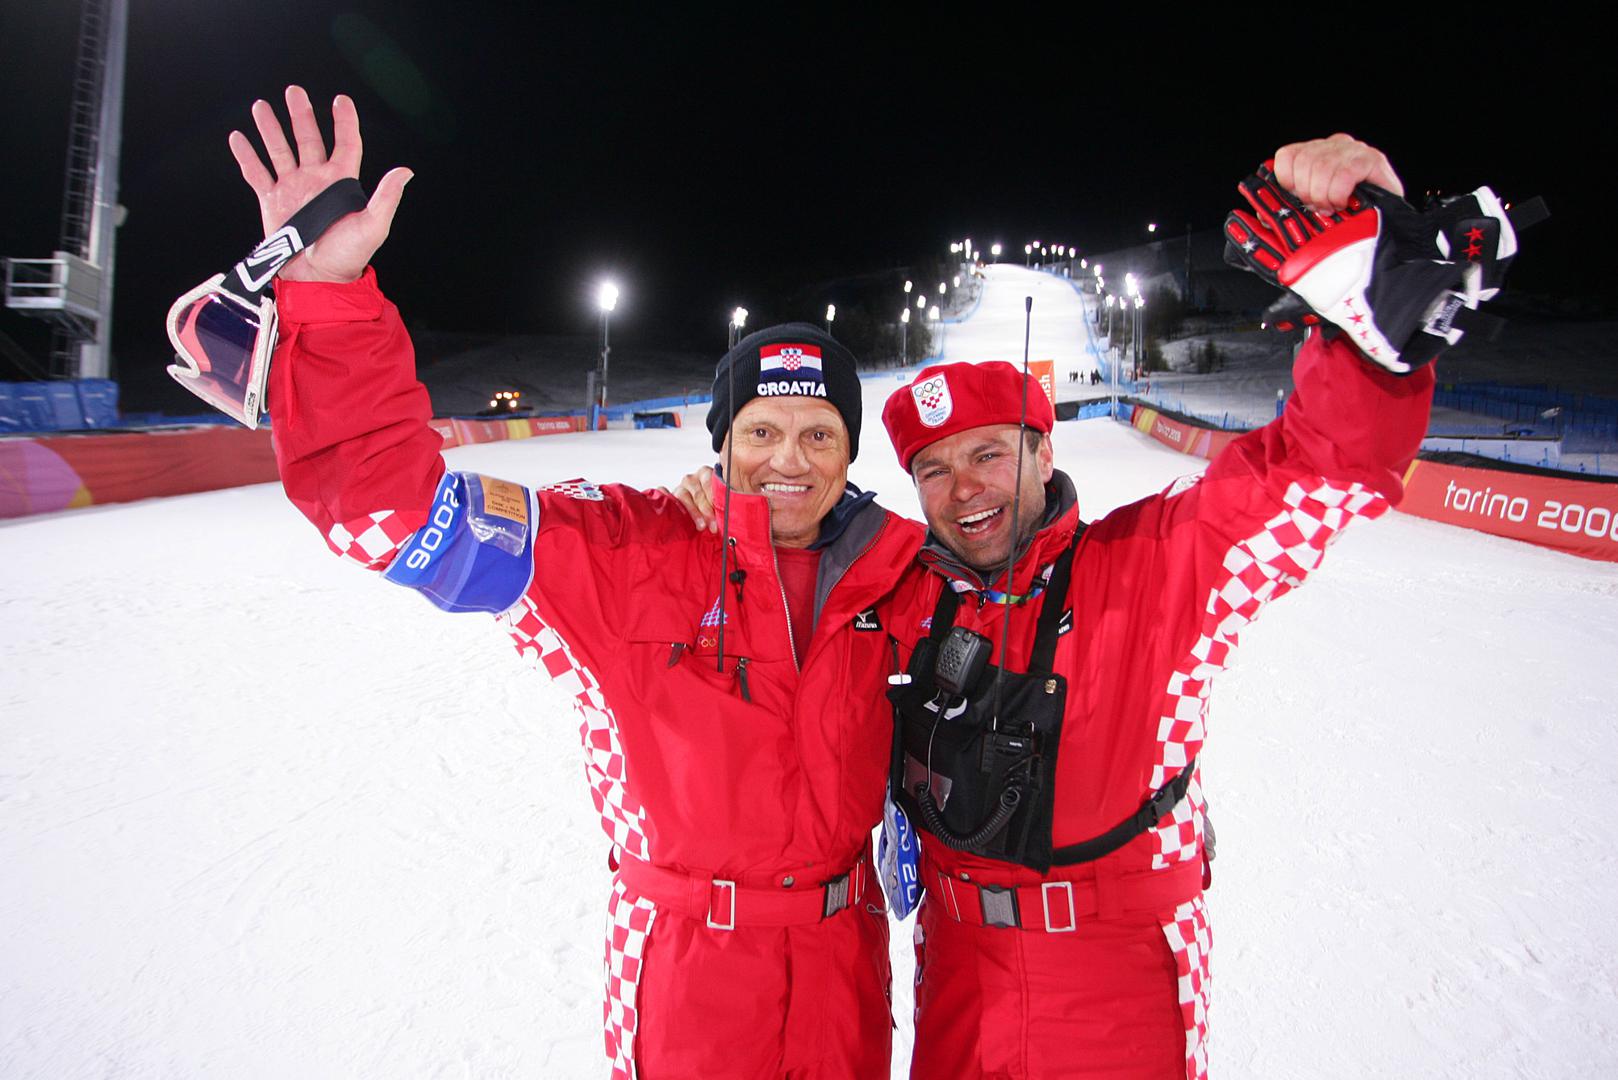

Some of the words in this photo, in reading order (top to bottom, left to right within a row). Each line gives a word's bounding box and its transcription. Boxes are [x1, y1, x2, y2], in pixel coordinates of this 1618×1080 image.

[757, 381, 827, 397] CROATIA
[1444, 479, 1529, 522] torino
[406, 487, 460, 570] 2006
